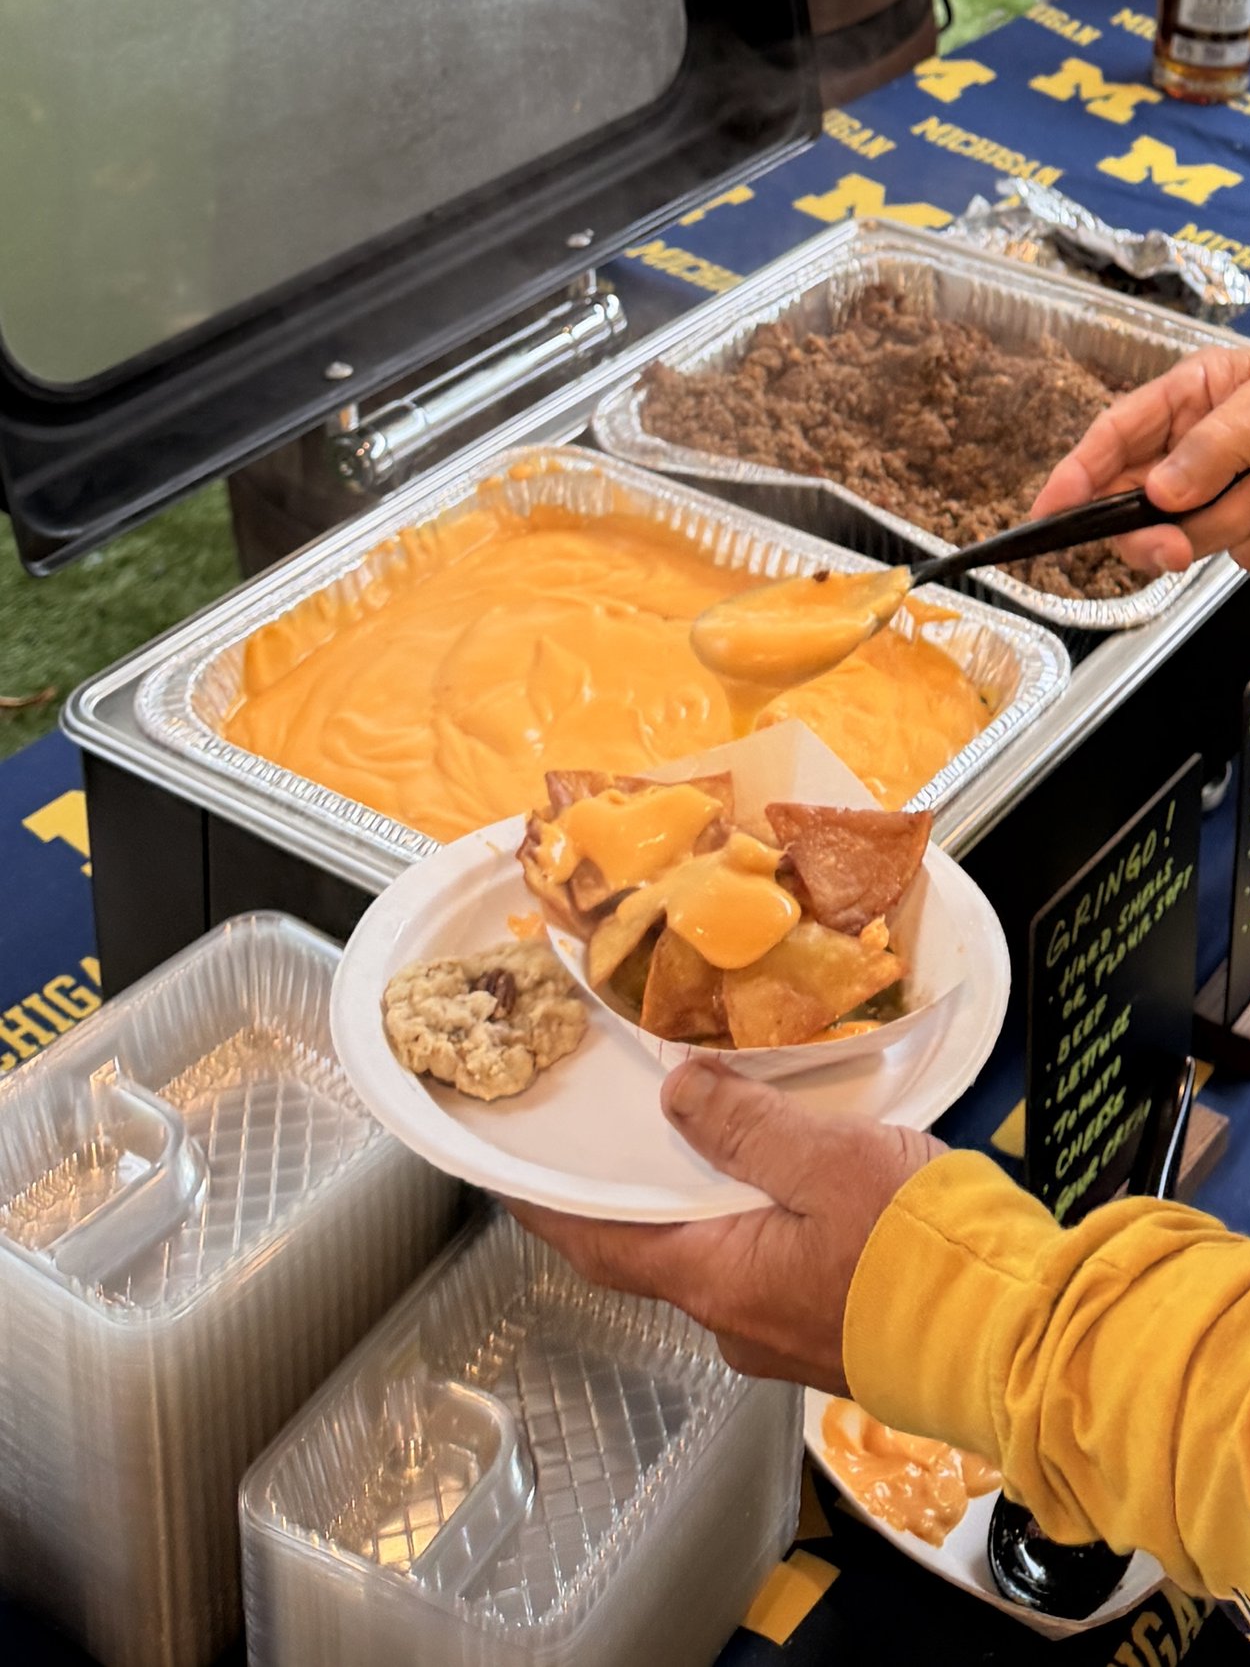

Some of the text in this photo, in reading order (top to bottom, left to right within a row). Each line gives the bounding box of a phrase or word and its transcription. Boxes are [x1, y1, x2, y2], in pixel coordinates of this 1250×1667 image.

[1029, 56, 1164, 125] M
[1096, 135, 1244, 207] M
[1046, 798, 1176, 968] GRINGO!
[1058, 927, 1112, 999] HARD
[1057, 993, 1109, 1066] BEEF
[1053, 1054, 1122, 1144] TOMATO
[1055, 1086, 1127, 1179] CHEESE
